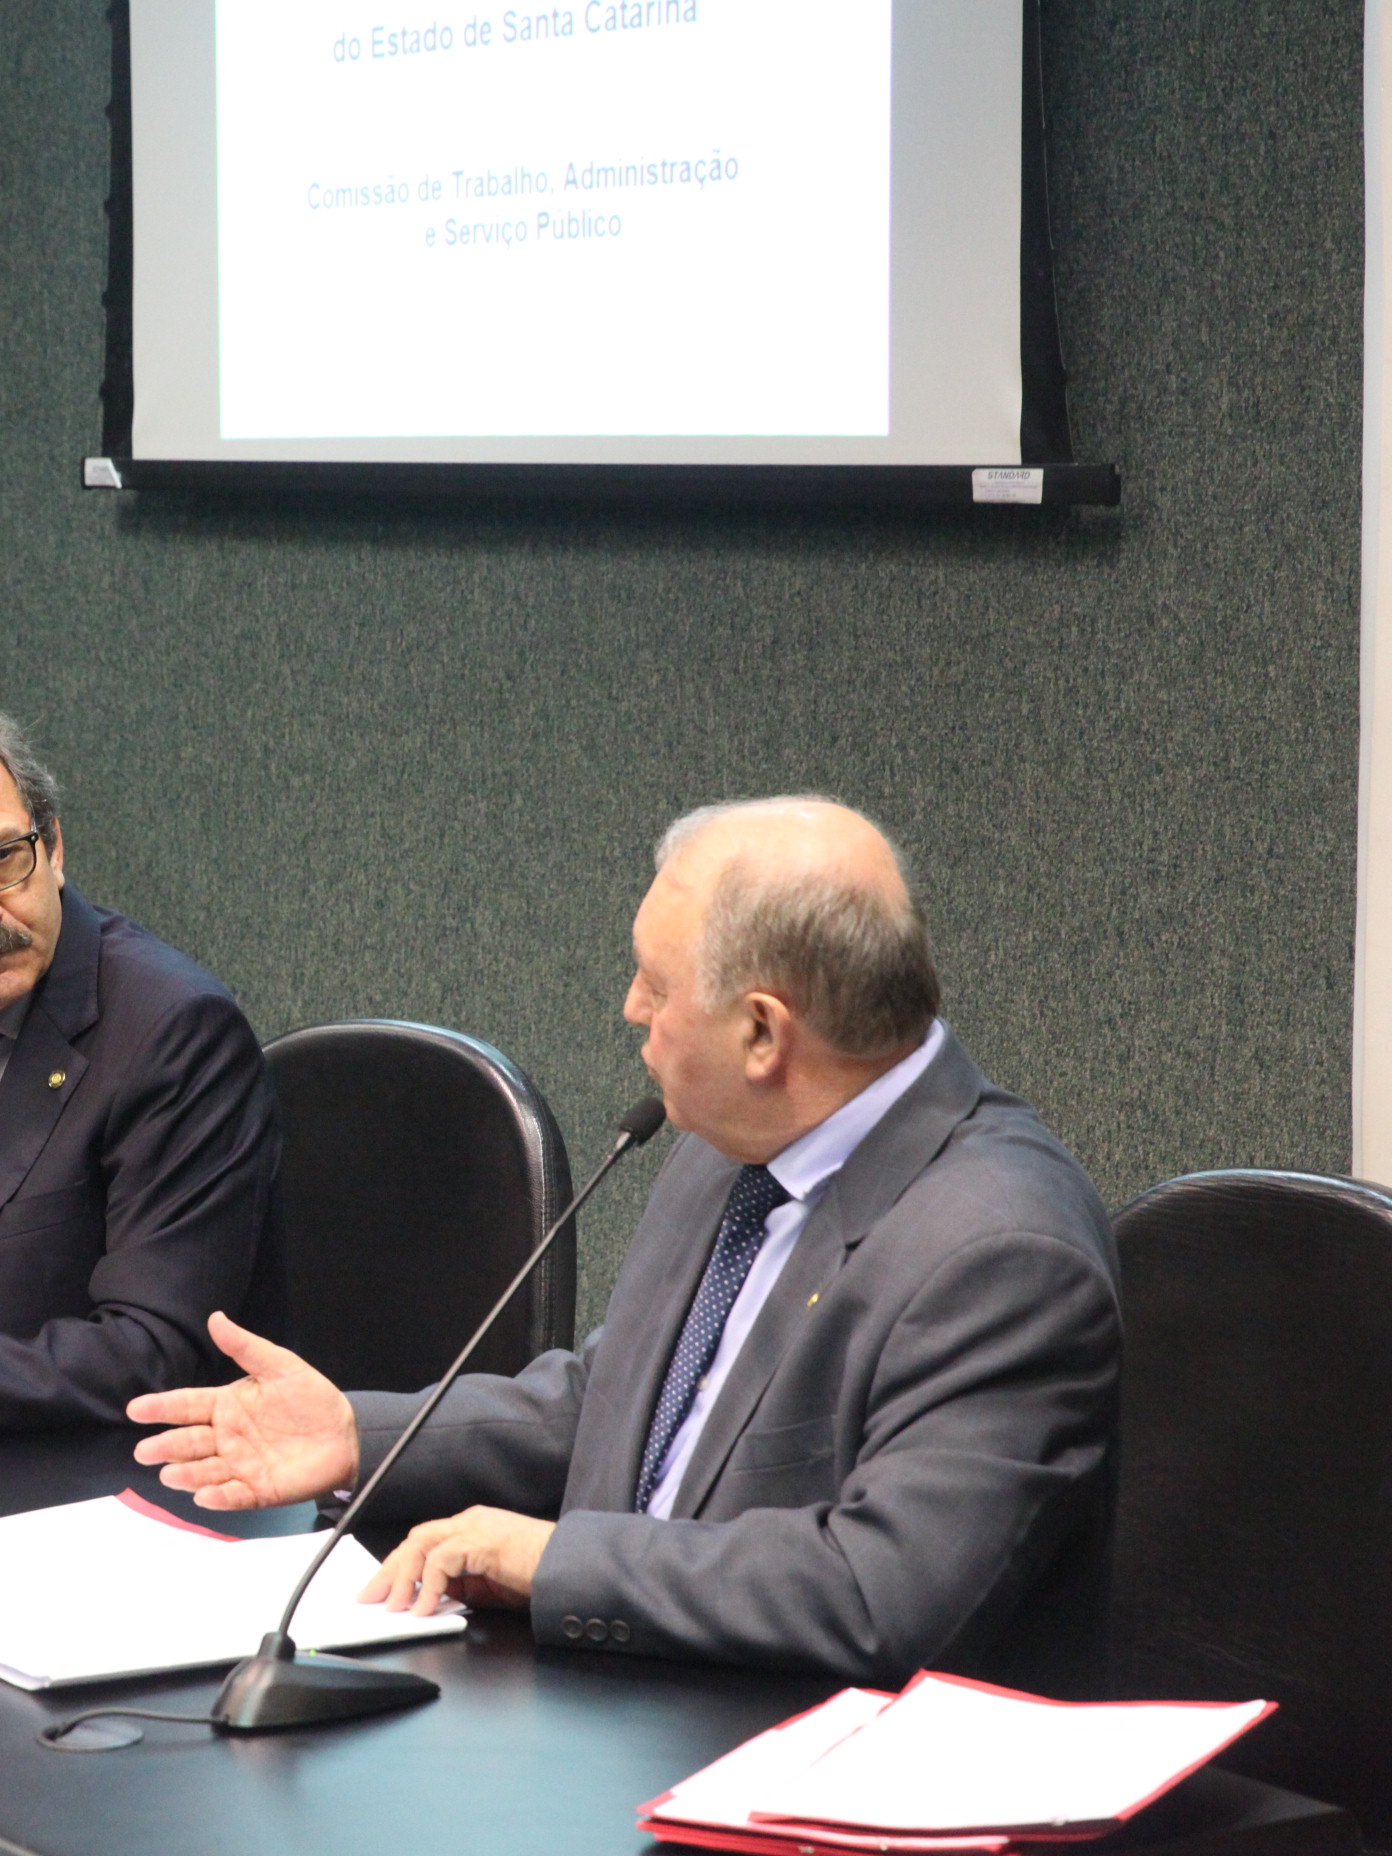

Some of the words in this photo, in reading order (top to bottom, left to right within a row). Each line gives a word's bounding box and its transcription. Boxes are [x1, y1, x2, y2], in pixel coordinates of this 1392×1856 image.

[333, 31, 362, 63] do
[371, 20, 454, 59] Estado
[463, 15, 493, 48] de
[502, 7, 575, 44] Santa
[584, 0, 699, 34] Catarina
[307, 174, 410, 210] Comissão
[418, 174, 443, 202] de
[563, 147, 740, 191] Administração
[425, 226, 437, 248] e
[445, 217, 528, 249] Serviço
[536, 207, 623, 241] Público
